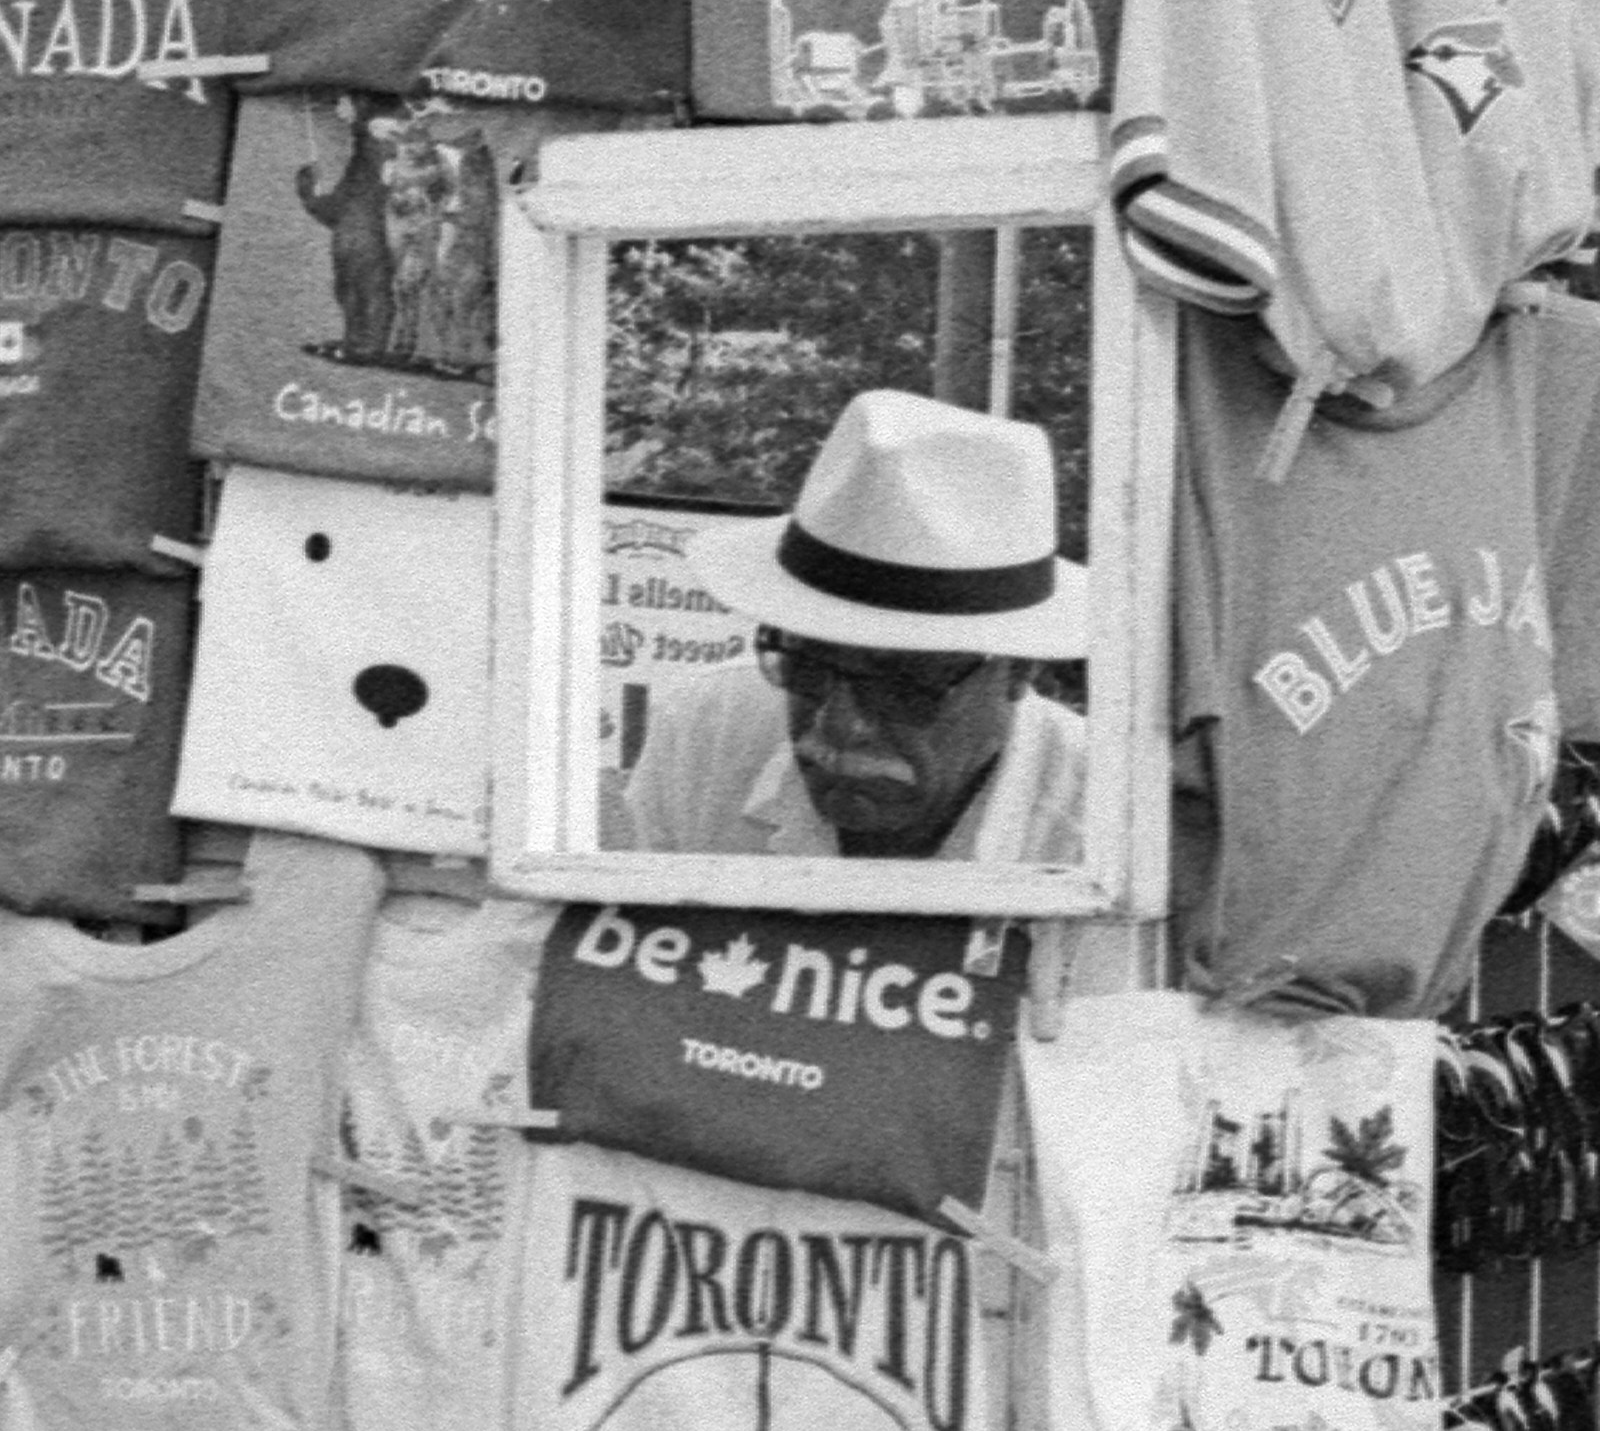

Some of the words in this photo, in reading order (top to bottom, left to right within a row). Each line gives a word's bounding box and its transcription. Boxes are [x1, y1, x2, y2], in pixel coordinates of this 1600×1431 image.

[420, 68, 546, 102] TORONTO
[275, 382, 449, 437] Canadian
[1254, 552, 1451, 733] BLUE
[1467, 546, 1555, 656] JA
[573, 908, 692, 983] be
[769, 943, 993, 1039] nice.
[681, 1037, 824, 1091] TORONTO
[70, 1294, 252, 1358] FRIEND
